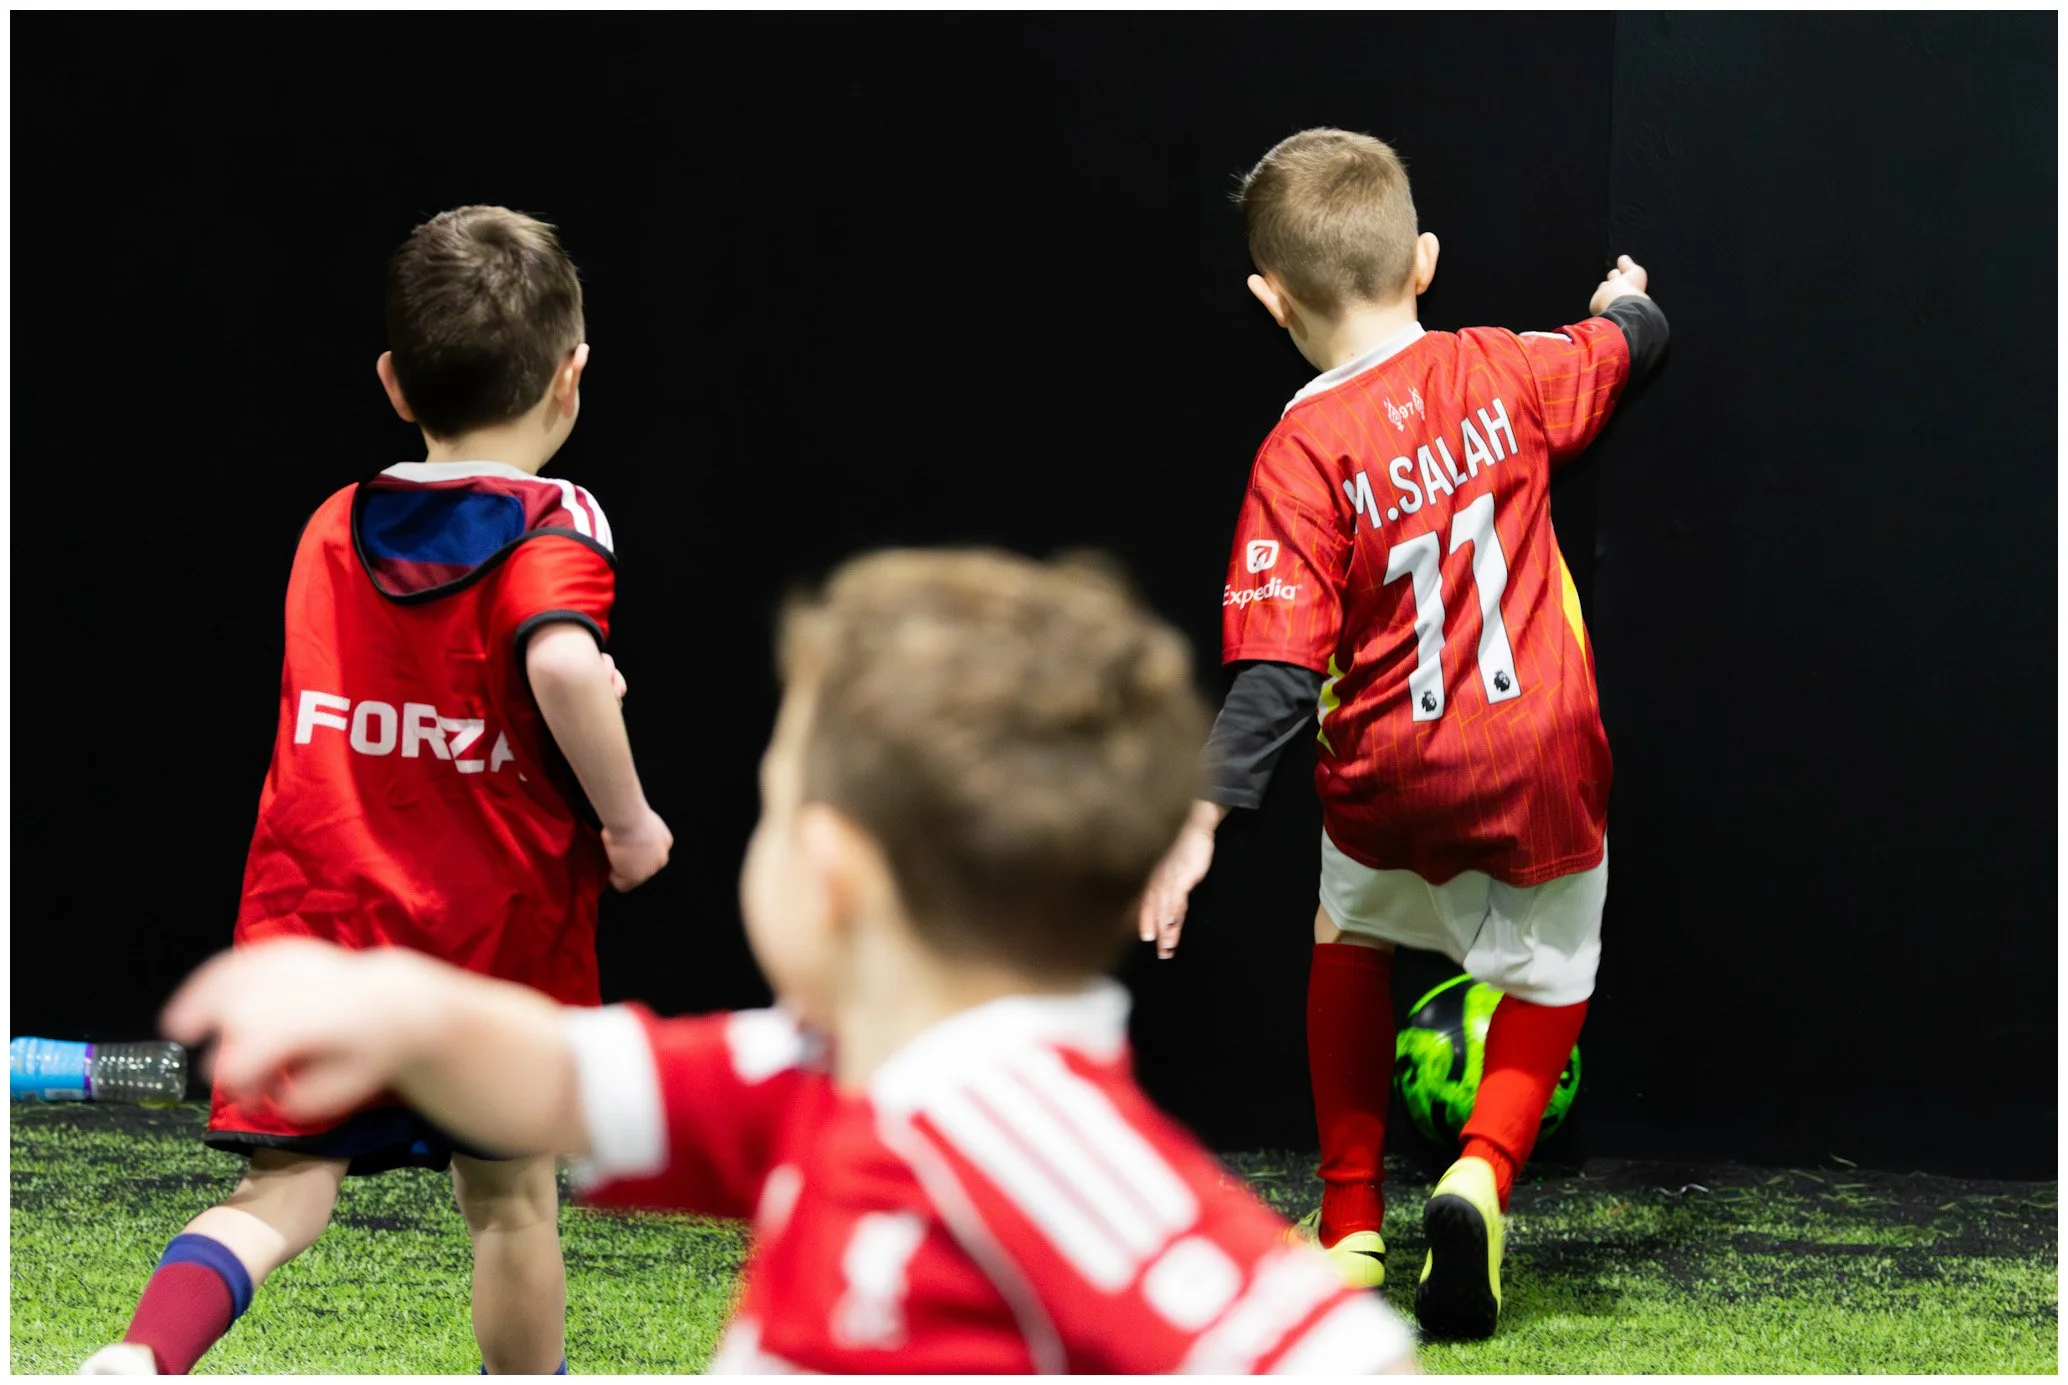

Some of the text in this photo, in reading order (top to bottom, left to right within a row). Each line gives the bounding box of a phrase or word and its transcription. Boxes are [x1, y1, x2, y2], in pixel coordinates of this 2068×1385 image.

[1399, 401, 1414, 419] 97
[1223, 577, 1297, 610] Expedia
[1383, 491, 1522, 722] 11
